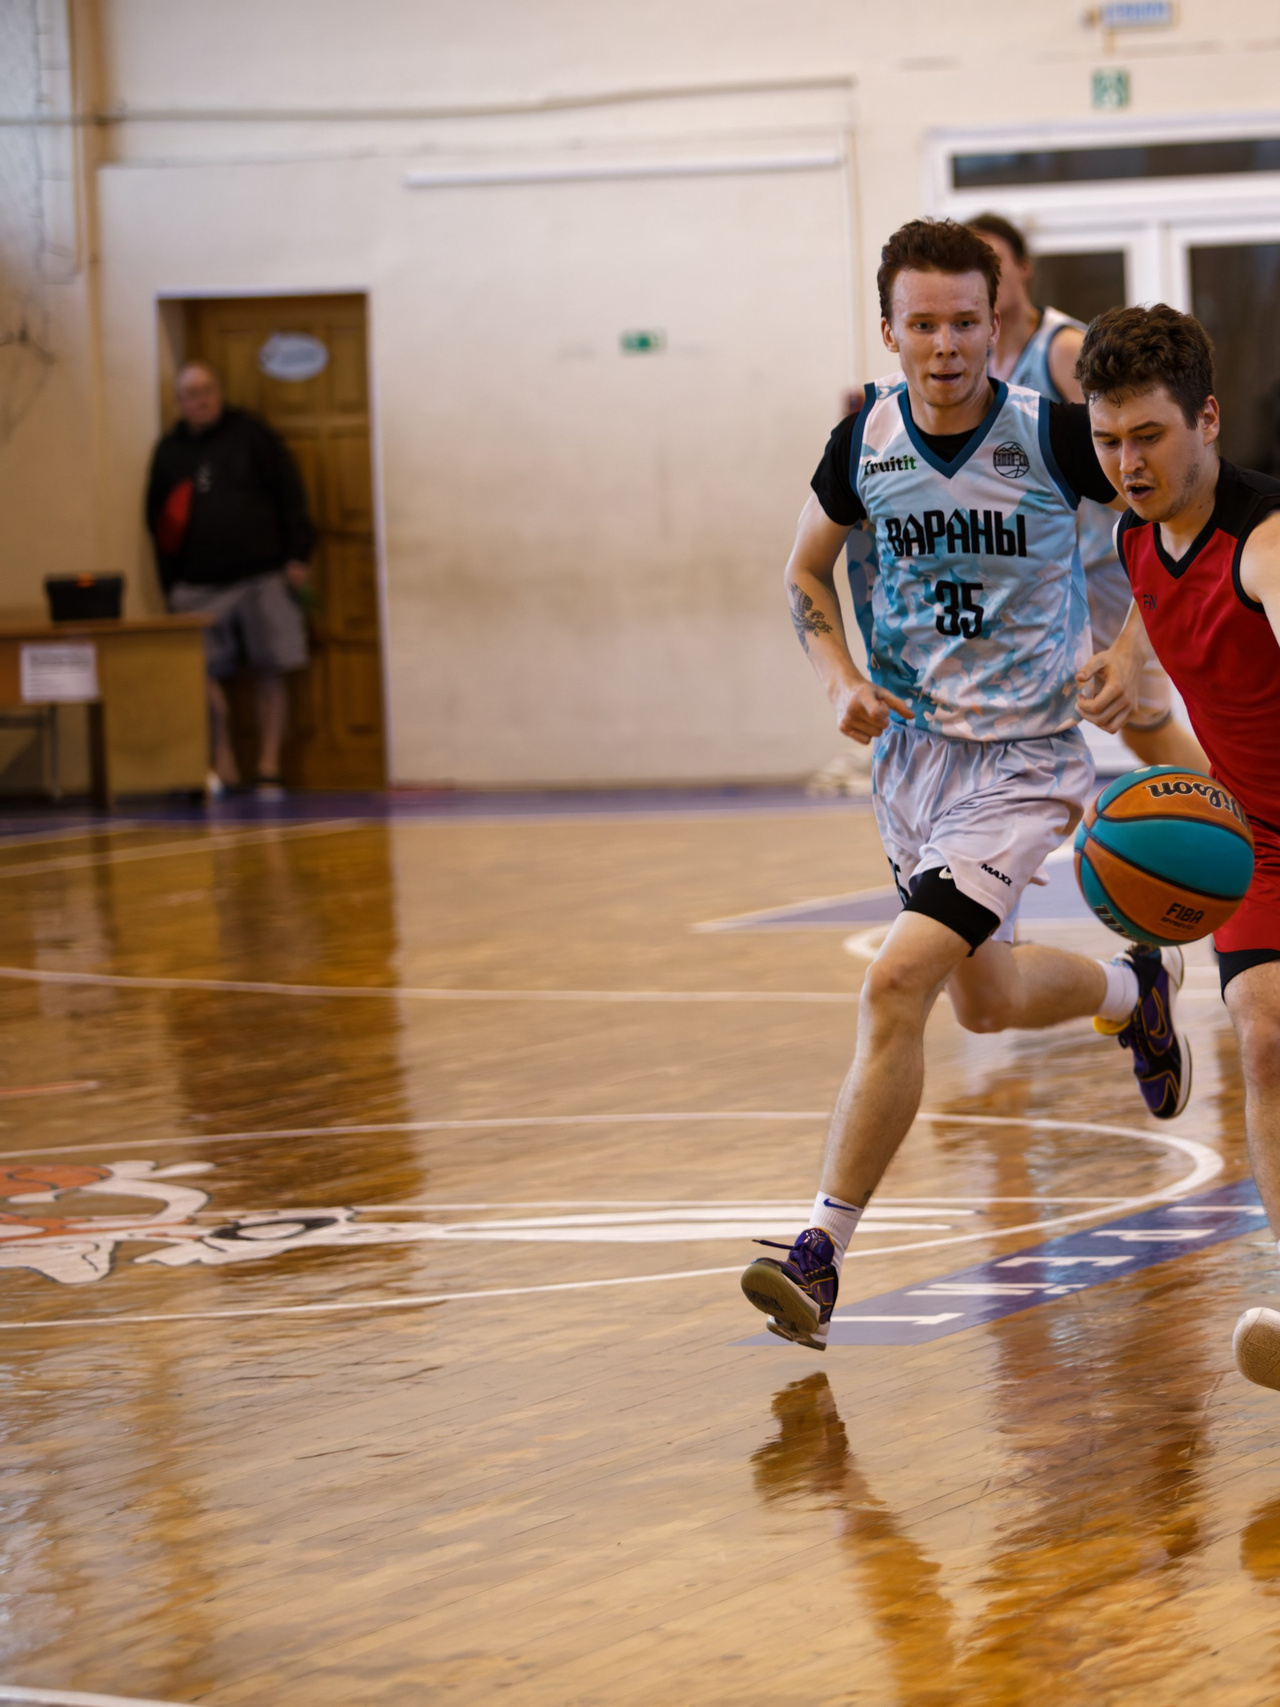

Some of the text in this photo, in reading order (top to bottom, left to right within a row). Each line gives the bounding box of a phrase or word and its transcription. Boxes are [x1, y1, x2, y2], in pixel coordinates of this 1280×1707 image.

[864, 454, 917, 476] fruitit
[885, 508, 1028, 558] ВАРАНЫ
[935, 579, 984, 639] 35
[1165, 902, 1205, 925] FIBA
